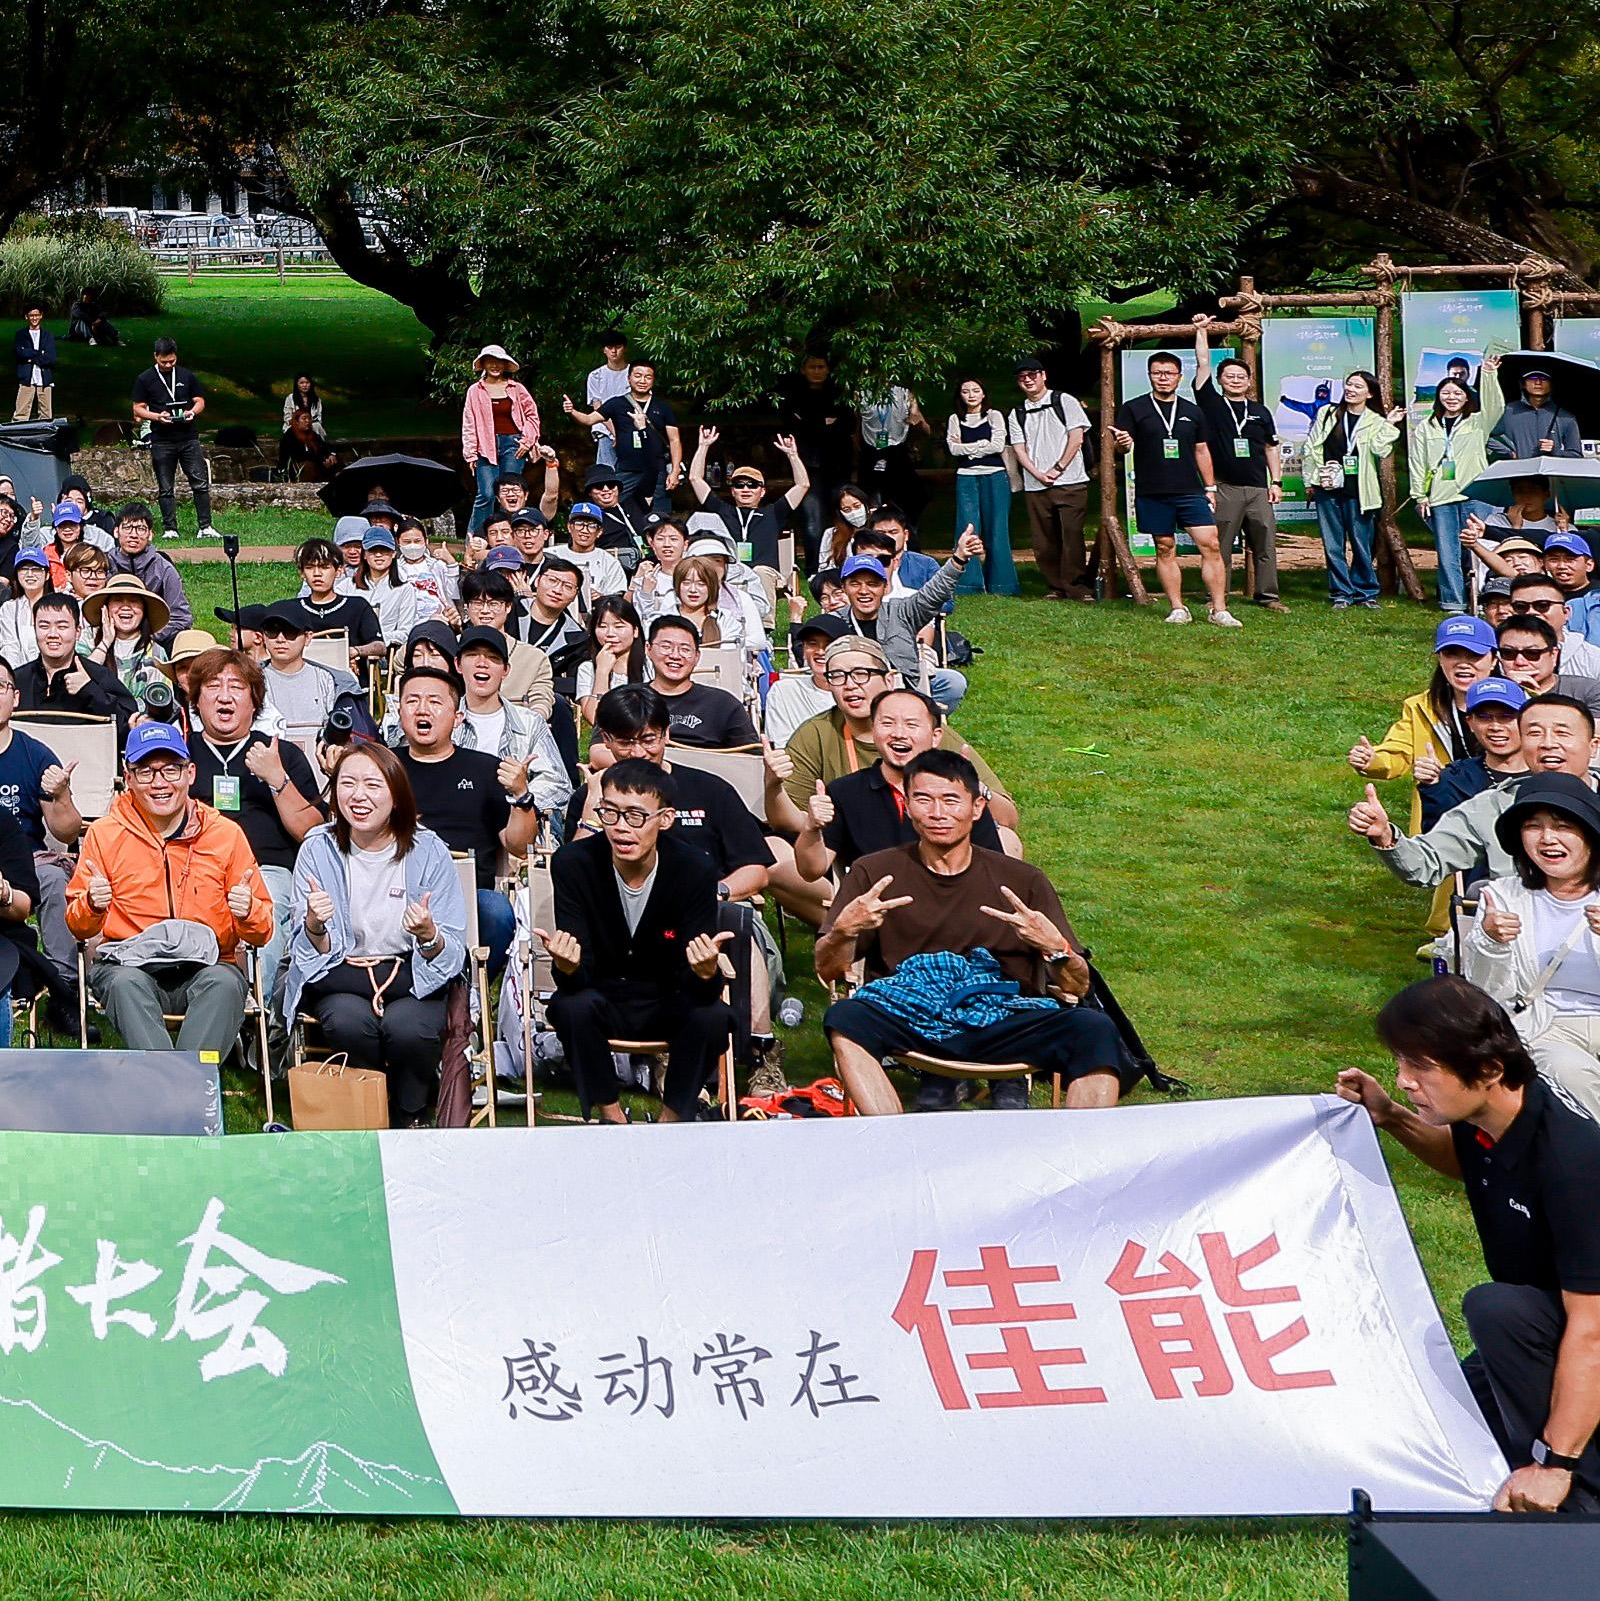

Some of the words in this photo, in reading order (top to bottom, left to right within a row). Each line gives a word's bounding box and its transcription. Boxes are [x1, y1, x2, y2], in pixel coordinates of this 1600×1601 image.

[499, 1329, 881, 1423] 感动常在
[891, 1231, 1338, 1412] 佳能
